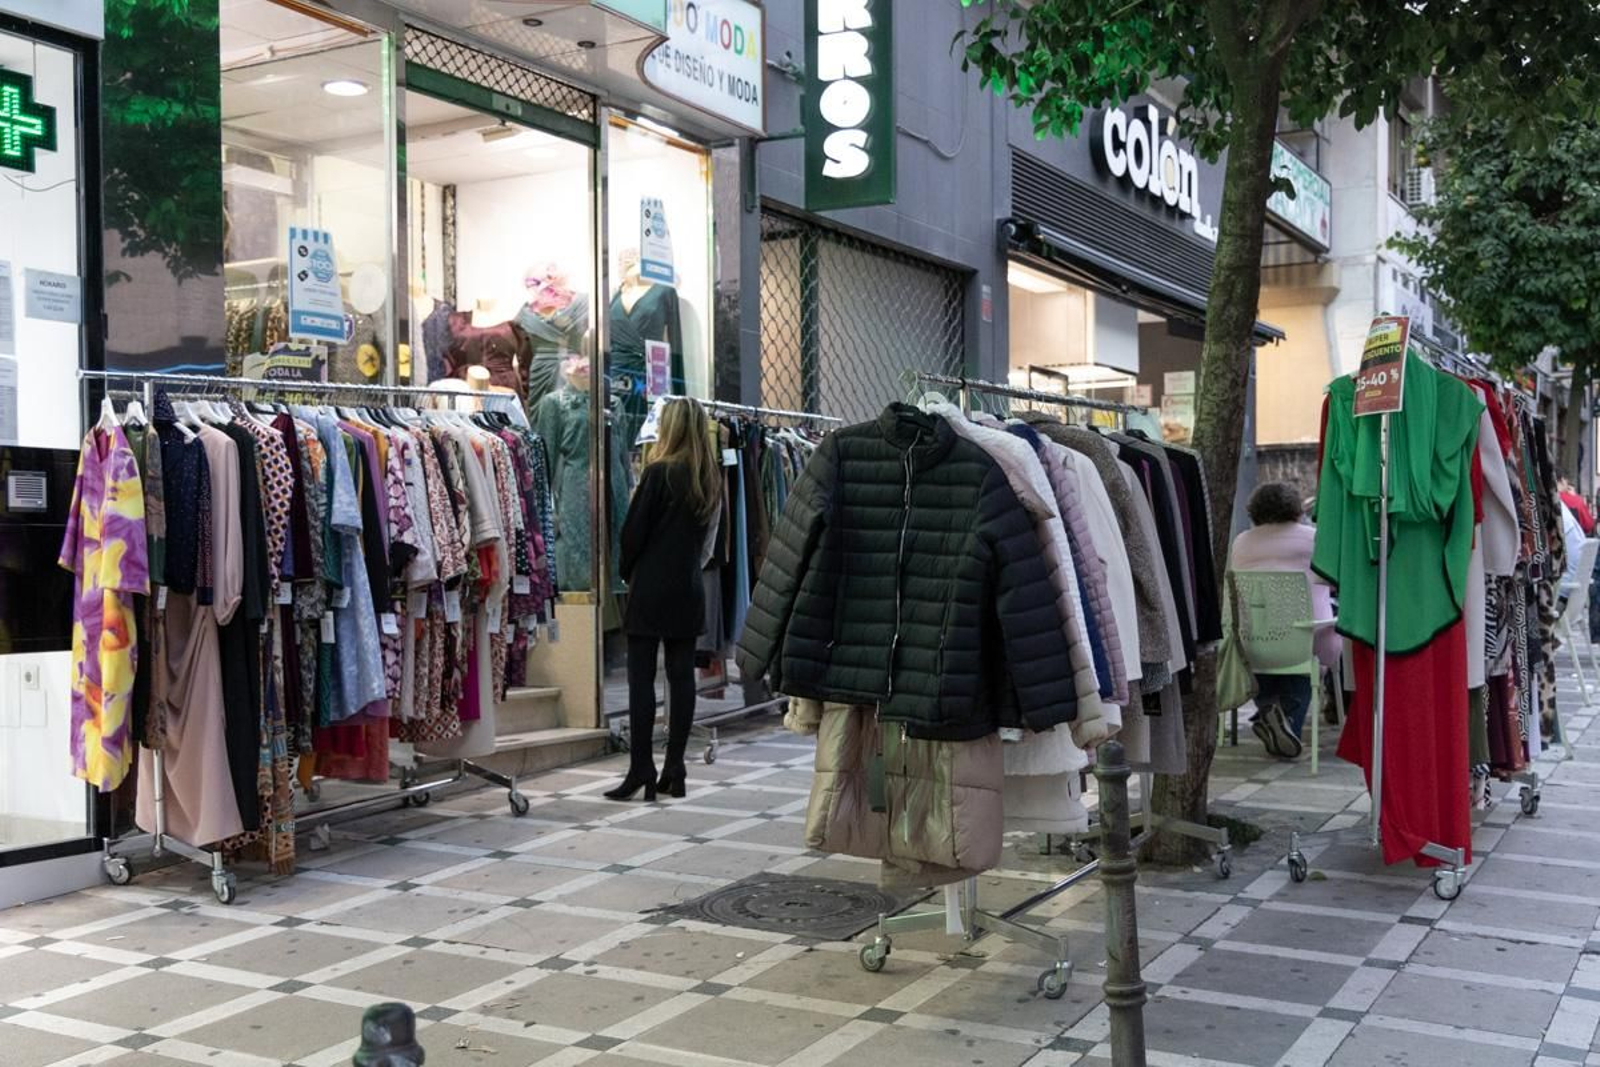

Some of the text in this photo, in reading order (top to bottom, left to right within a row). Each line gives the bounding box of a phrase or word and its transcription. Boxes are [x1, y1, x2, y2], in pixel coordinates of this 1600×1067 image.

[705, 10, 758, 61] MODA
[674, 49, 714, 88] DISEÑO
[717, 69, 724, 91] Y
[727, 74, 759, 106] MODA
[1103, 103, 1201, 220] colón
